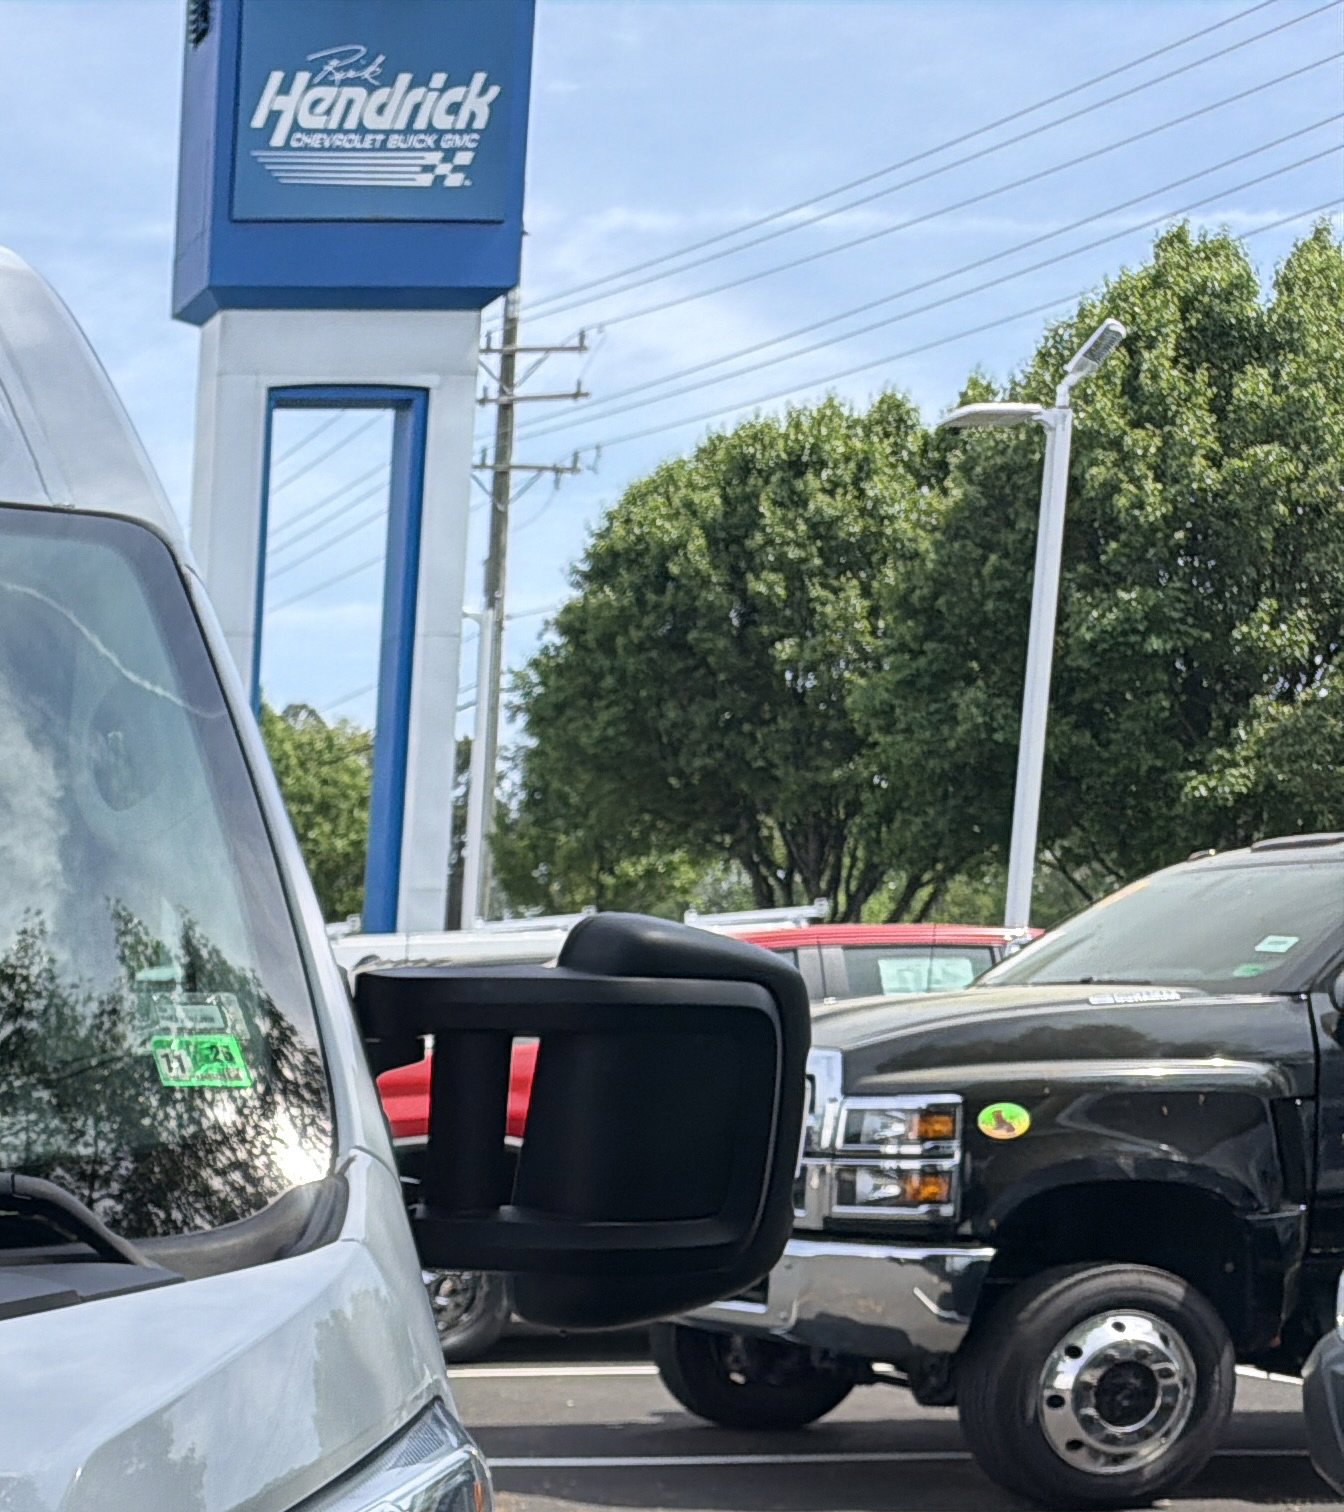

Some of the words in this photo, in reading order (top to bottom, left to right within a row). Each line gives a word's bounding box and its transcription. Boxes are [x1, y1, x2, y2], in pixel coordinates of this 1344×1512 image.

[250, 70, 501, 147] Hendrick
[290, 132, 385, 149] CHEVROLET
[387, 133, 437, 149] BUICK
[440, 133, 480, 149] GMC
